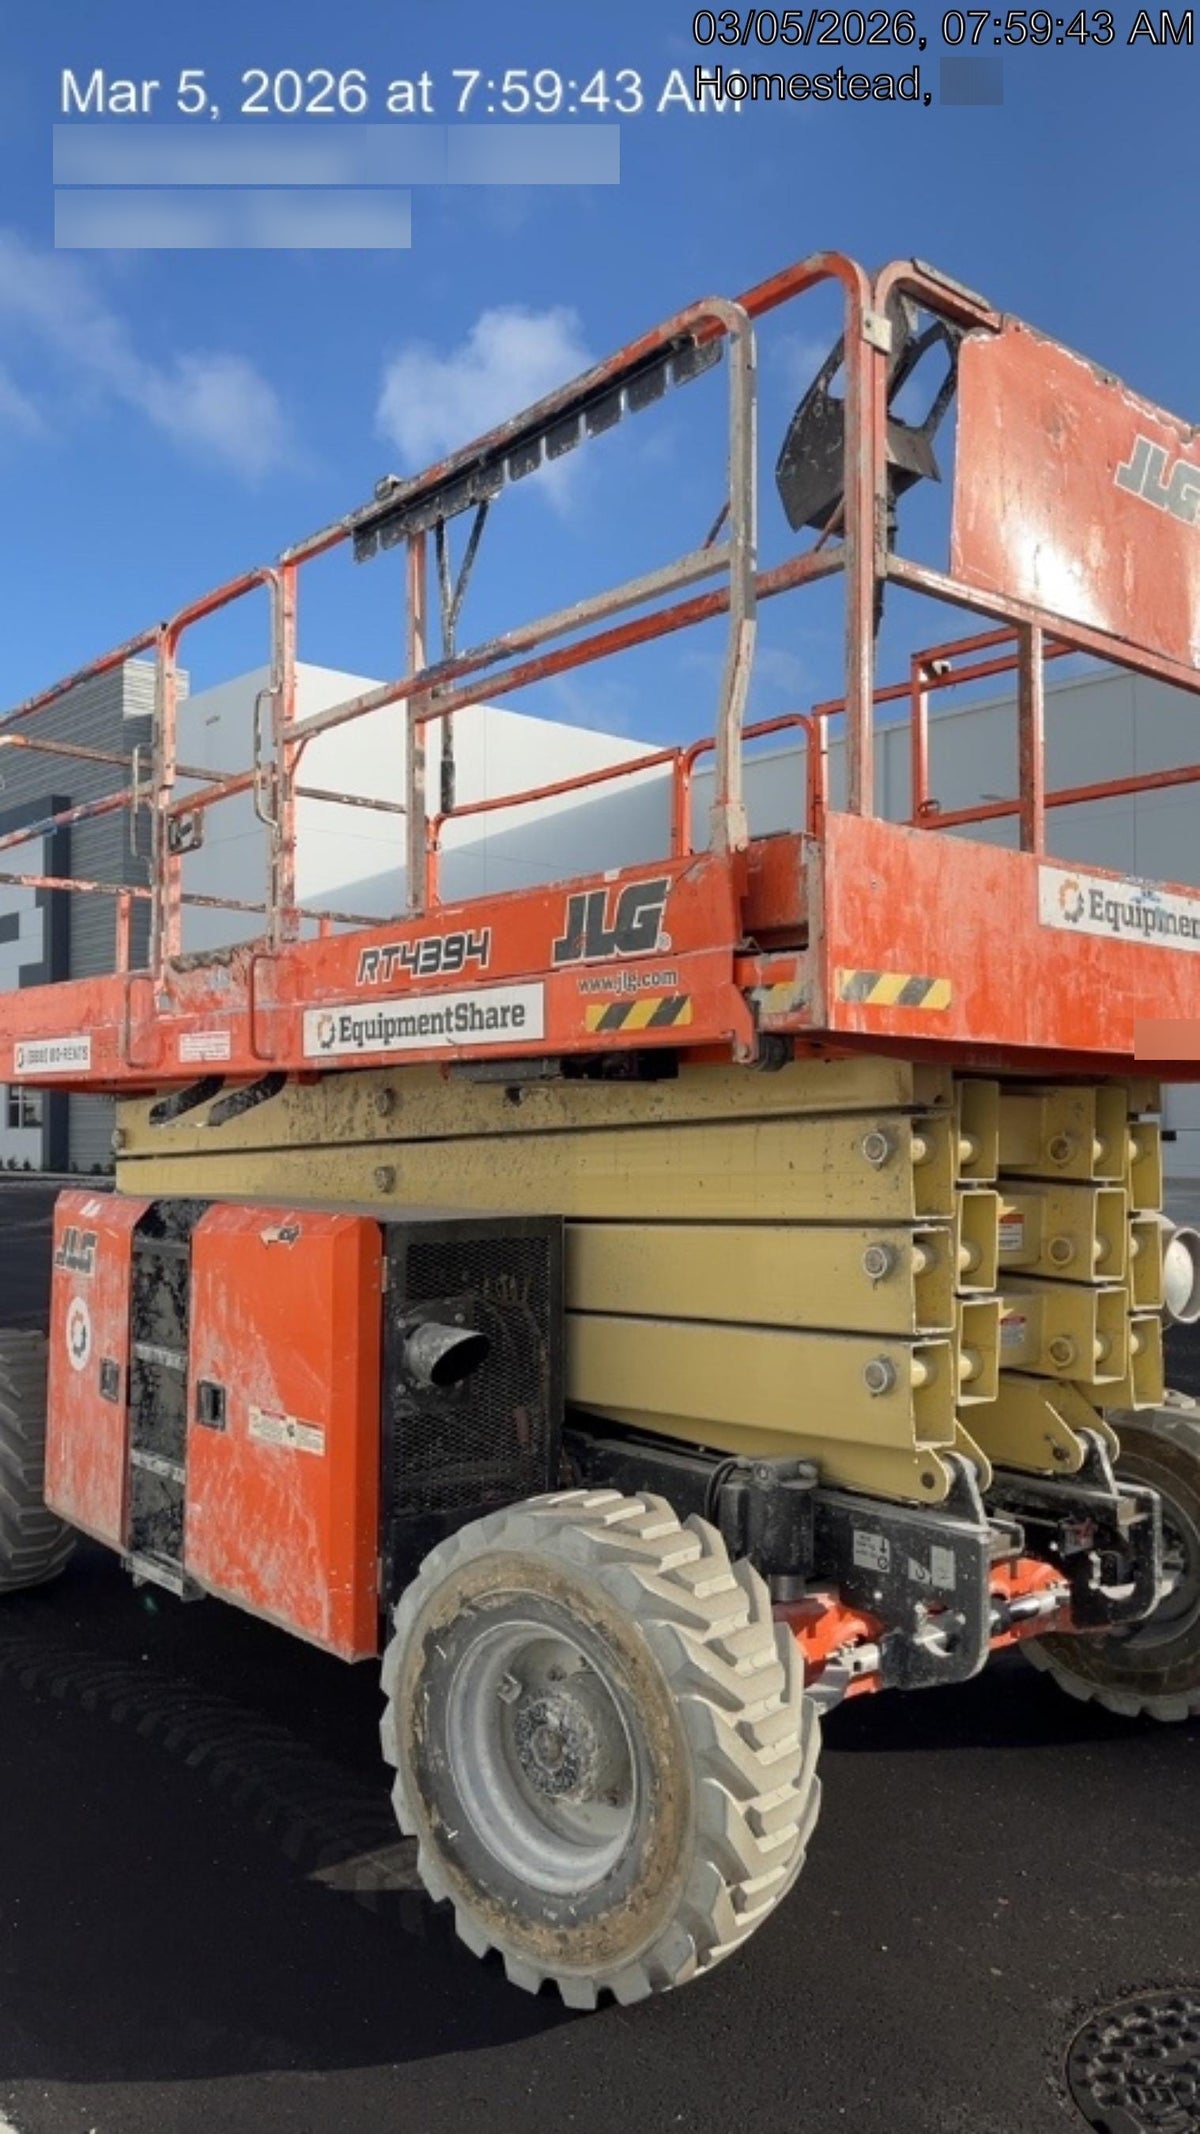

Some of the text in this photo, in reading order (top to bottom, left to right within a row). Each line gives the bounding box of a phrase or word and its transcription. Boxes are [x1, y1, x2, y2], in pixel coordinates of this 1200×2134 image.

[1114, 433, 1200, 527] JLG
[552, 876, 671, 967] JLG
[356, 927, 491, 986] RT4394
[578, 970, 678, 995] www.jlg.com
[339, 1002, 525, 1048] EquipmentShare
[55, 1226, 97, 1275] JLG
